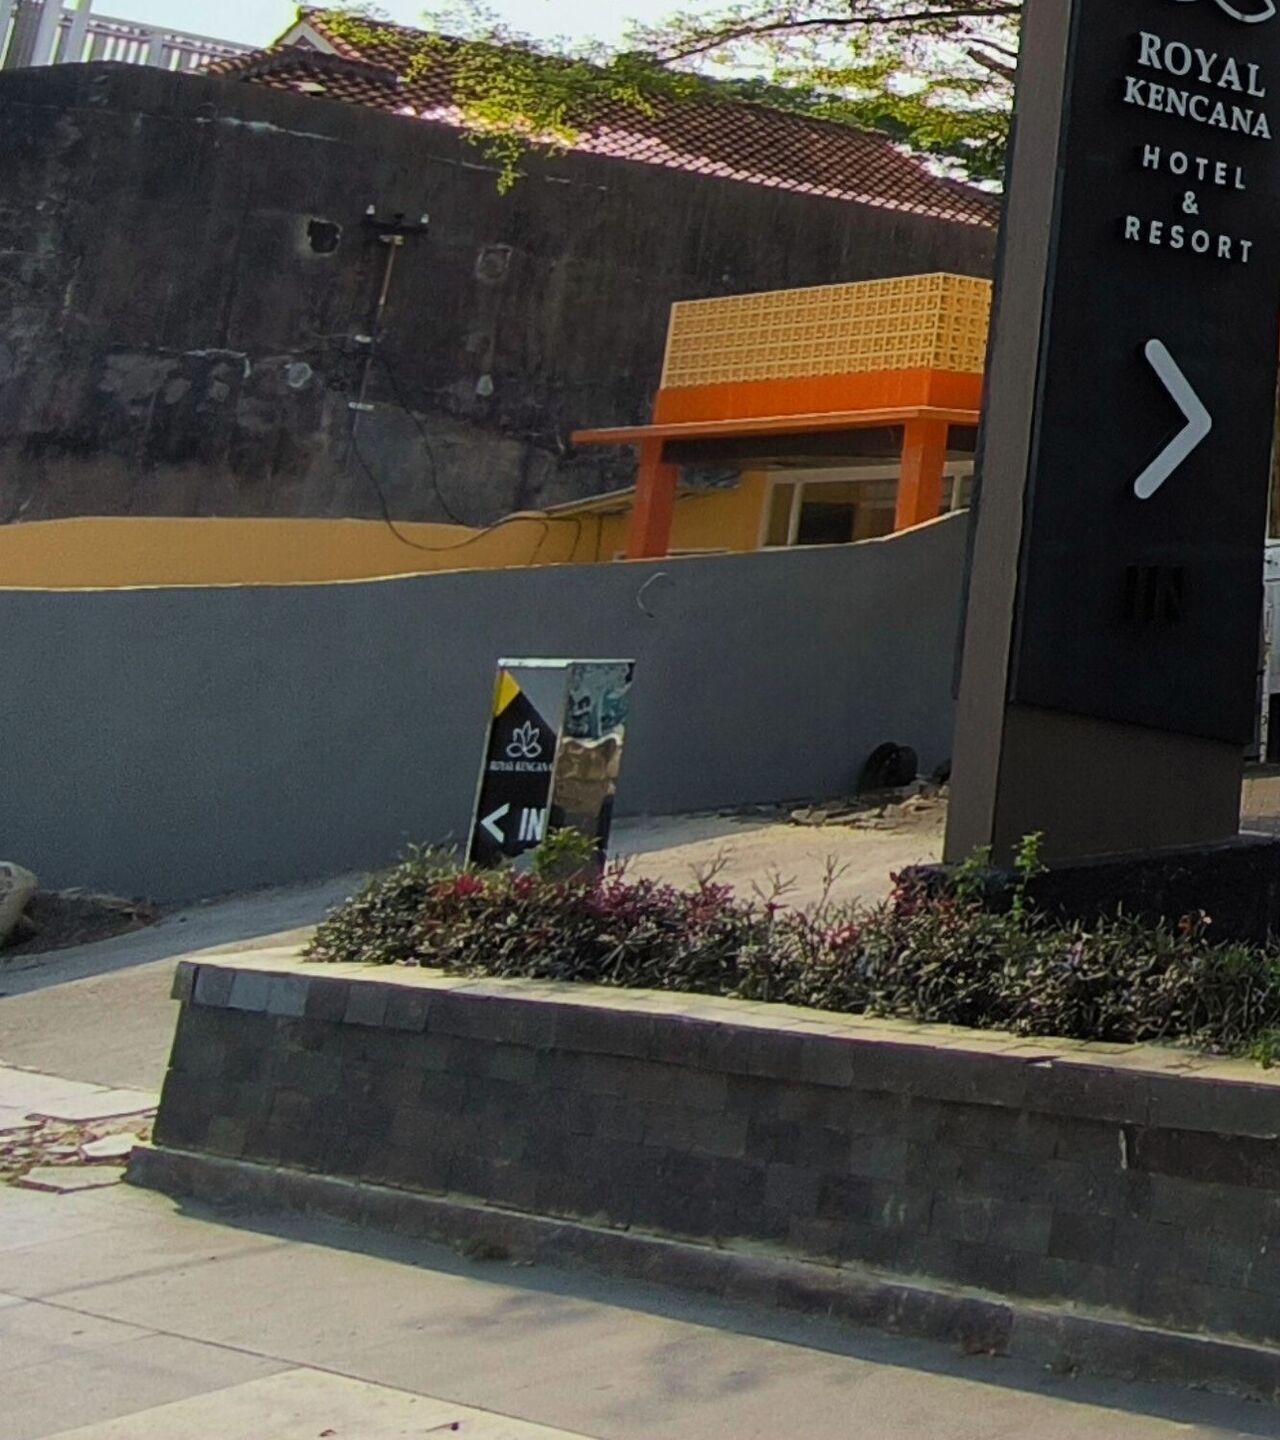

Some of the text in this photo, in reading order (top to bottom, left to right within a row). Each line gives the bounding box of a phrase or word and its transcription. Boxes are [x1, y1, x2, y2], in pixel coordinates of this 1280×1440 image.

[1138, 31, 1266, 97] ROYAL
[1123, 76, 1272, 139] KENCANA
[1142, 144, 1246, 190] HOTEL
[1182, 191, 1199, 215] &
[1125, 216, 1253, 263] RESORT
[518, 807, 548, 841] IN
